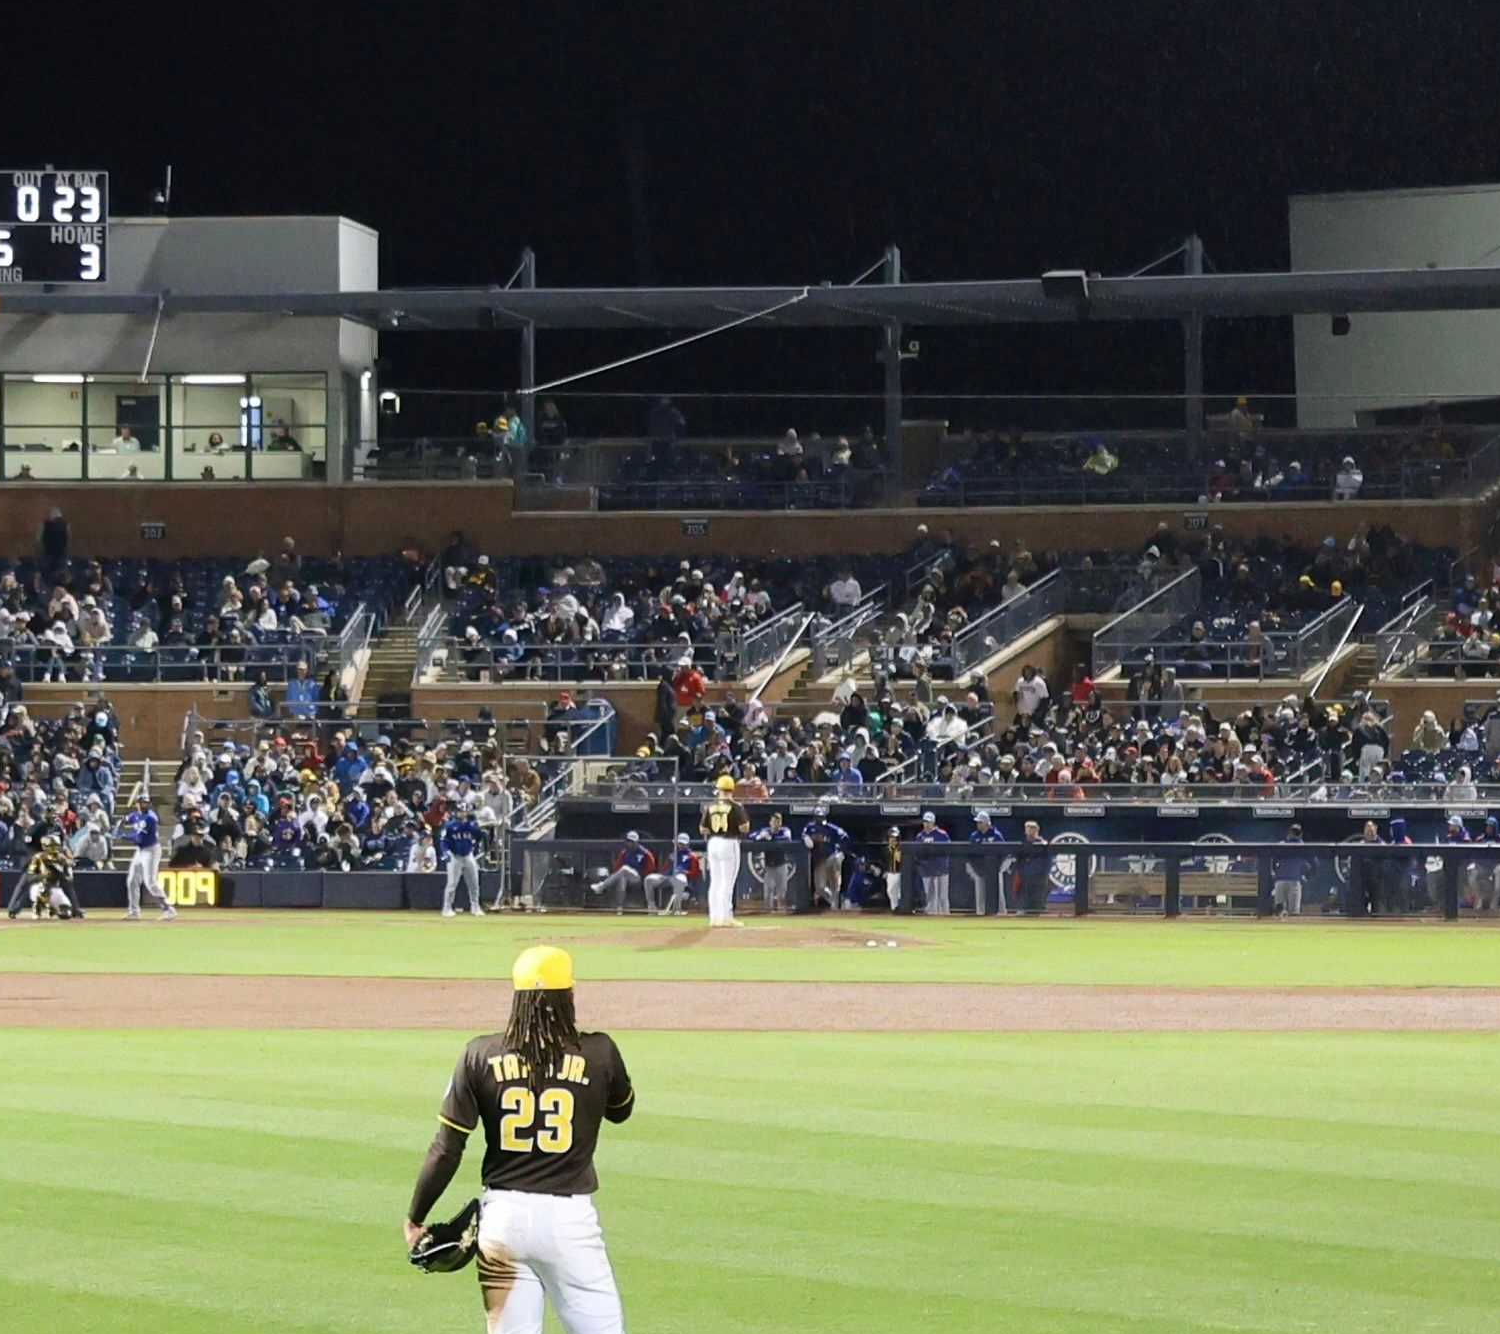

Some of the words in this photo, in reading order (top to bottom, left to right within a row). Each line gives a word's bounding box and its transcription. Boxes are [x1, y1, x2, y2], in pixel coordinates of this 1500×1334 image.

[13, 172, 44, 188] OUT
[56, 173, 70, 187] AT
[74, 173, 98, 187] BAT
[17, 186, 39, 222] 0
[53, 186, 100, 223] 23
[51, 226, 103, 244] HOME
[80, 244, 100, 280] 3
[557, 1054, 590, 1085] JR.
[501, 1087, 574, 1153] 23
